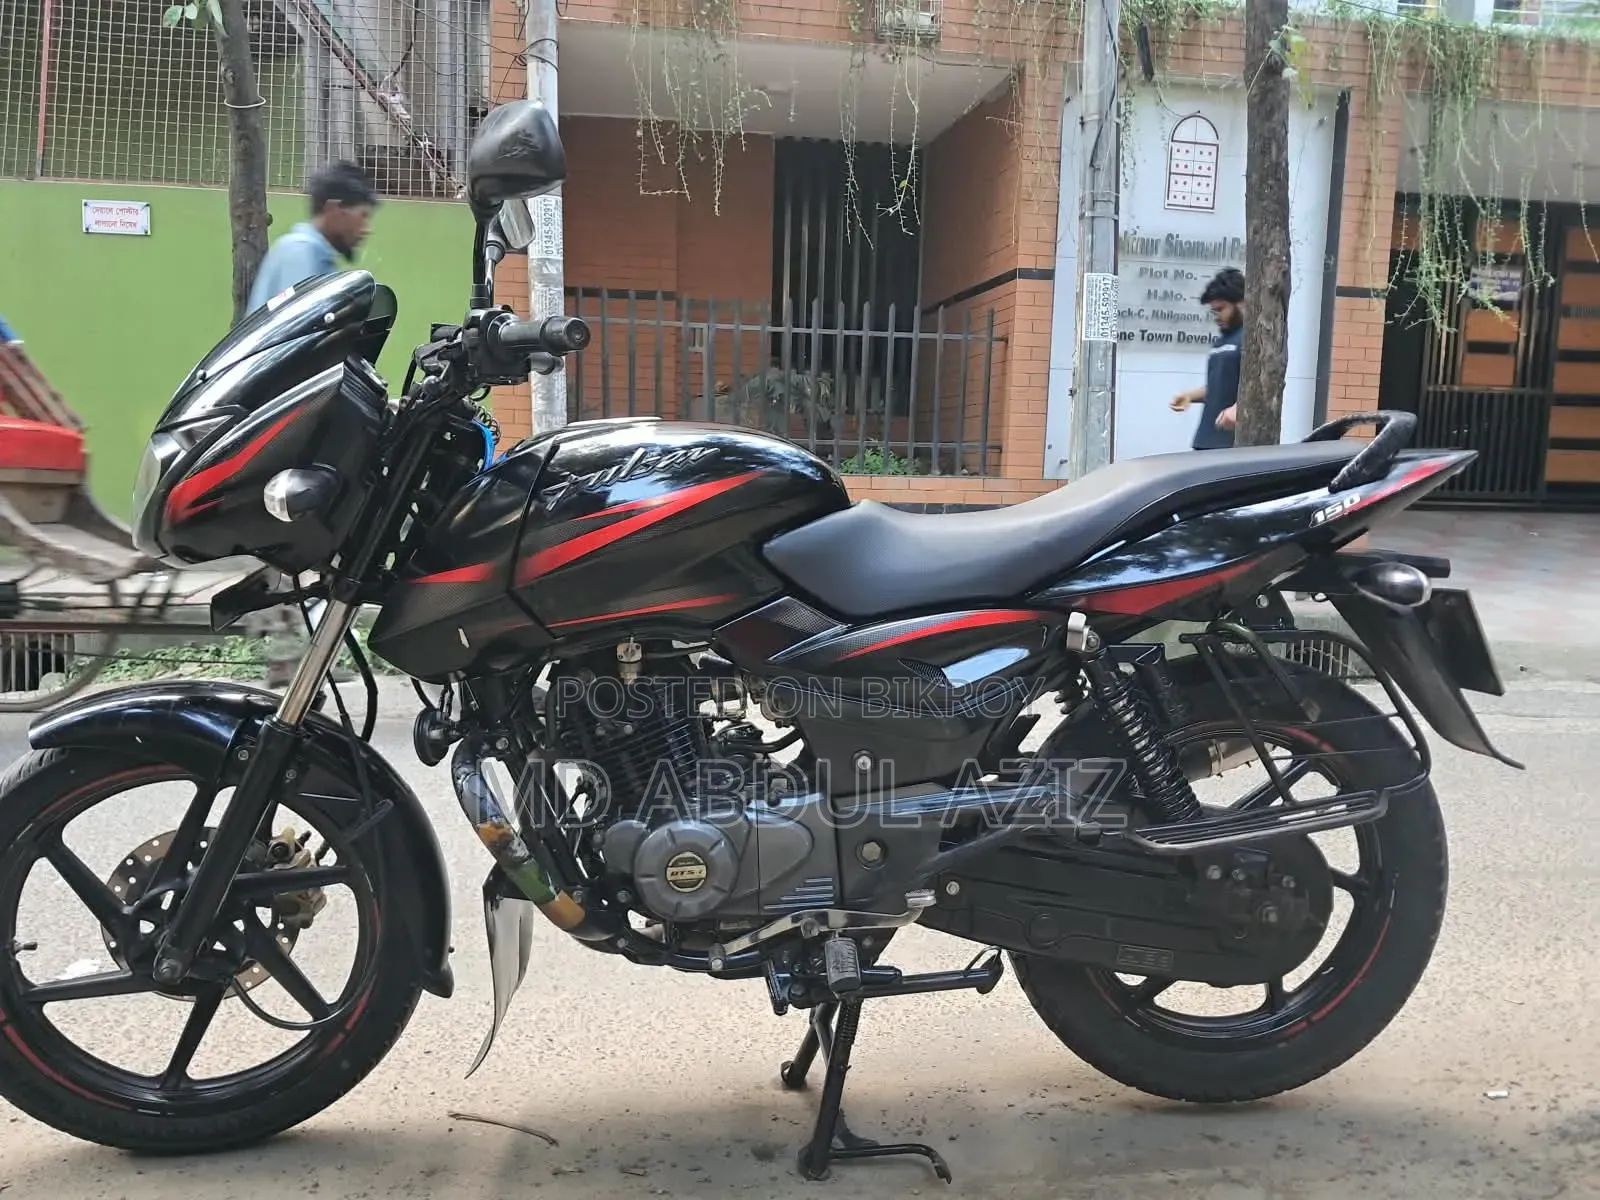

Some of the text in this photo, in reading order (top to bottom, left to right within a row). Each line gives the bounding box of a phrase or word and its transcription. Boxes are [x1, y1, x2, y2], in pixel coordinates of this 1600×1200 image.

[1139, 266, 1198, 281] Plot No.
[1140, 329, 1173, 343] Town
[1178, 331, 1217, 345] Develo
